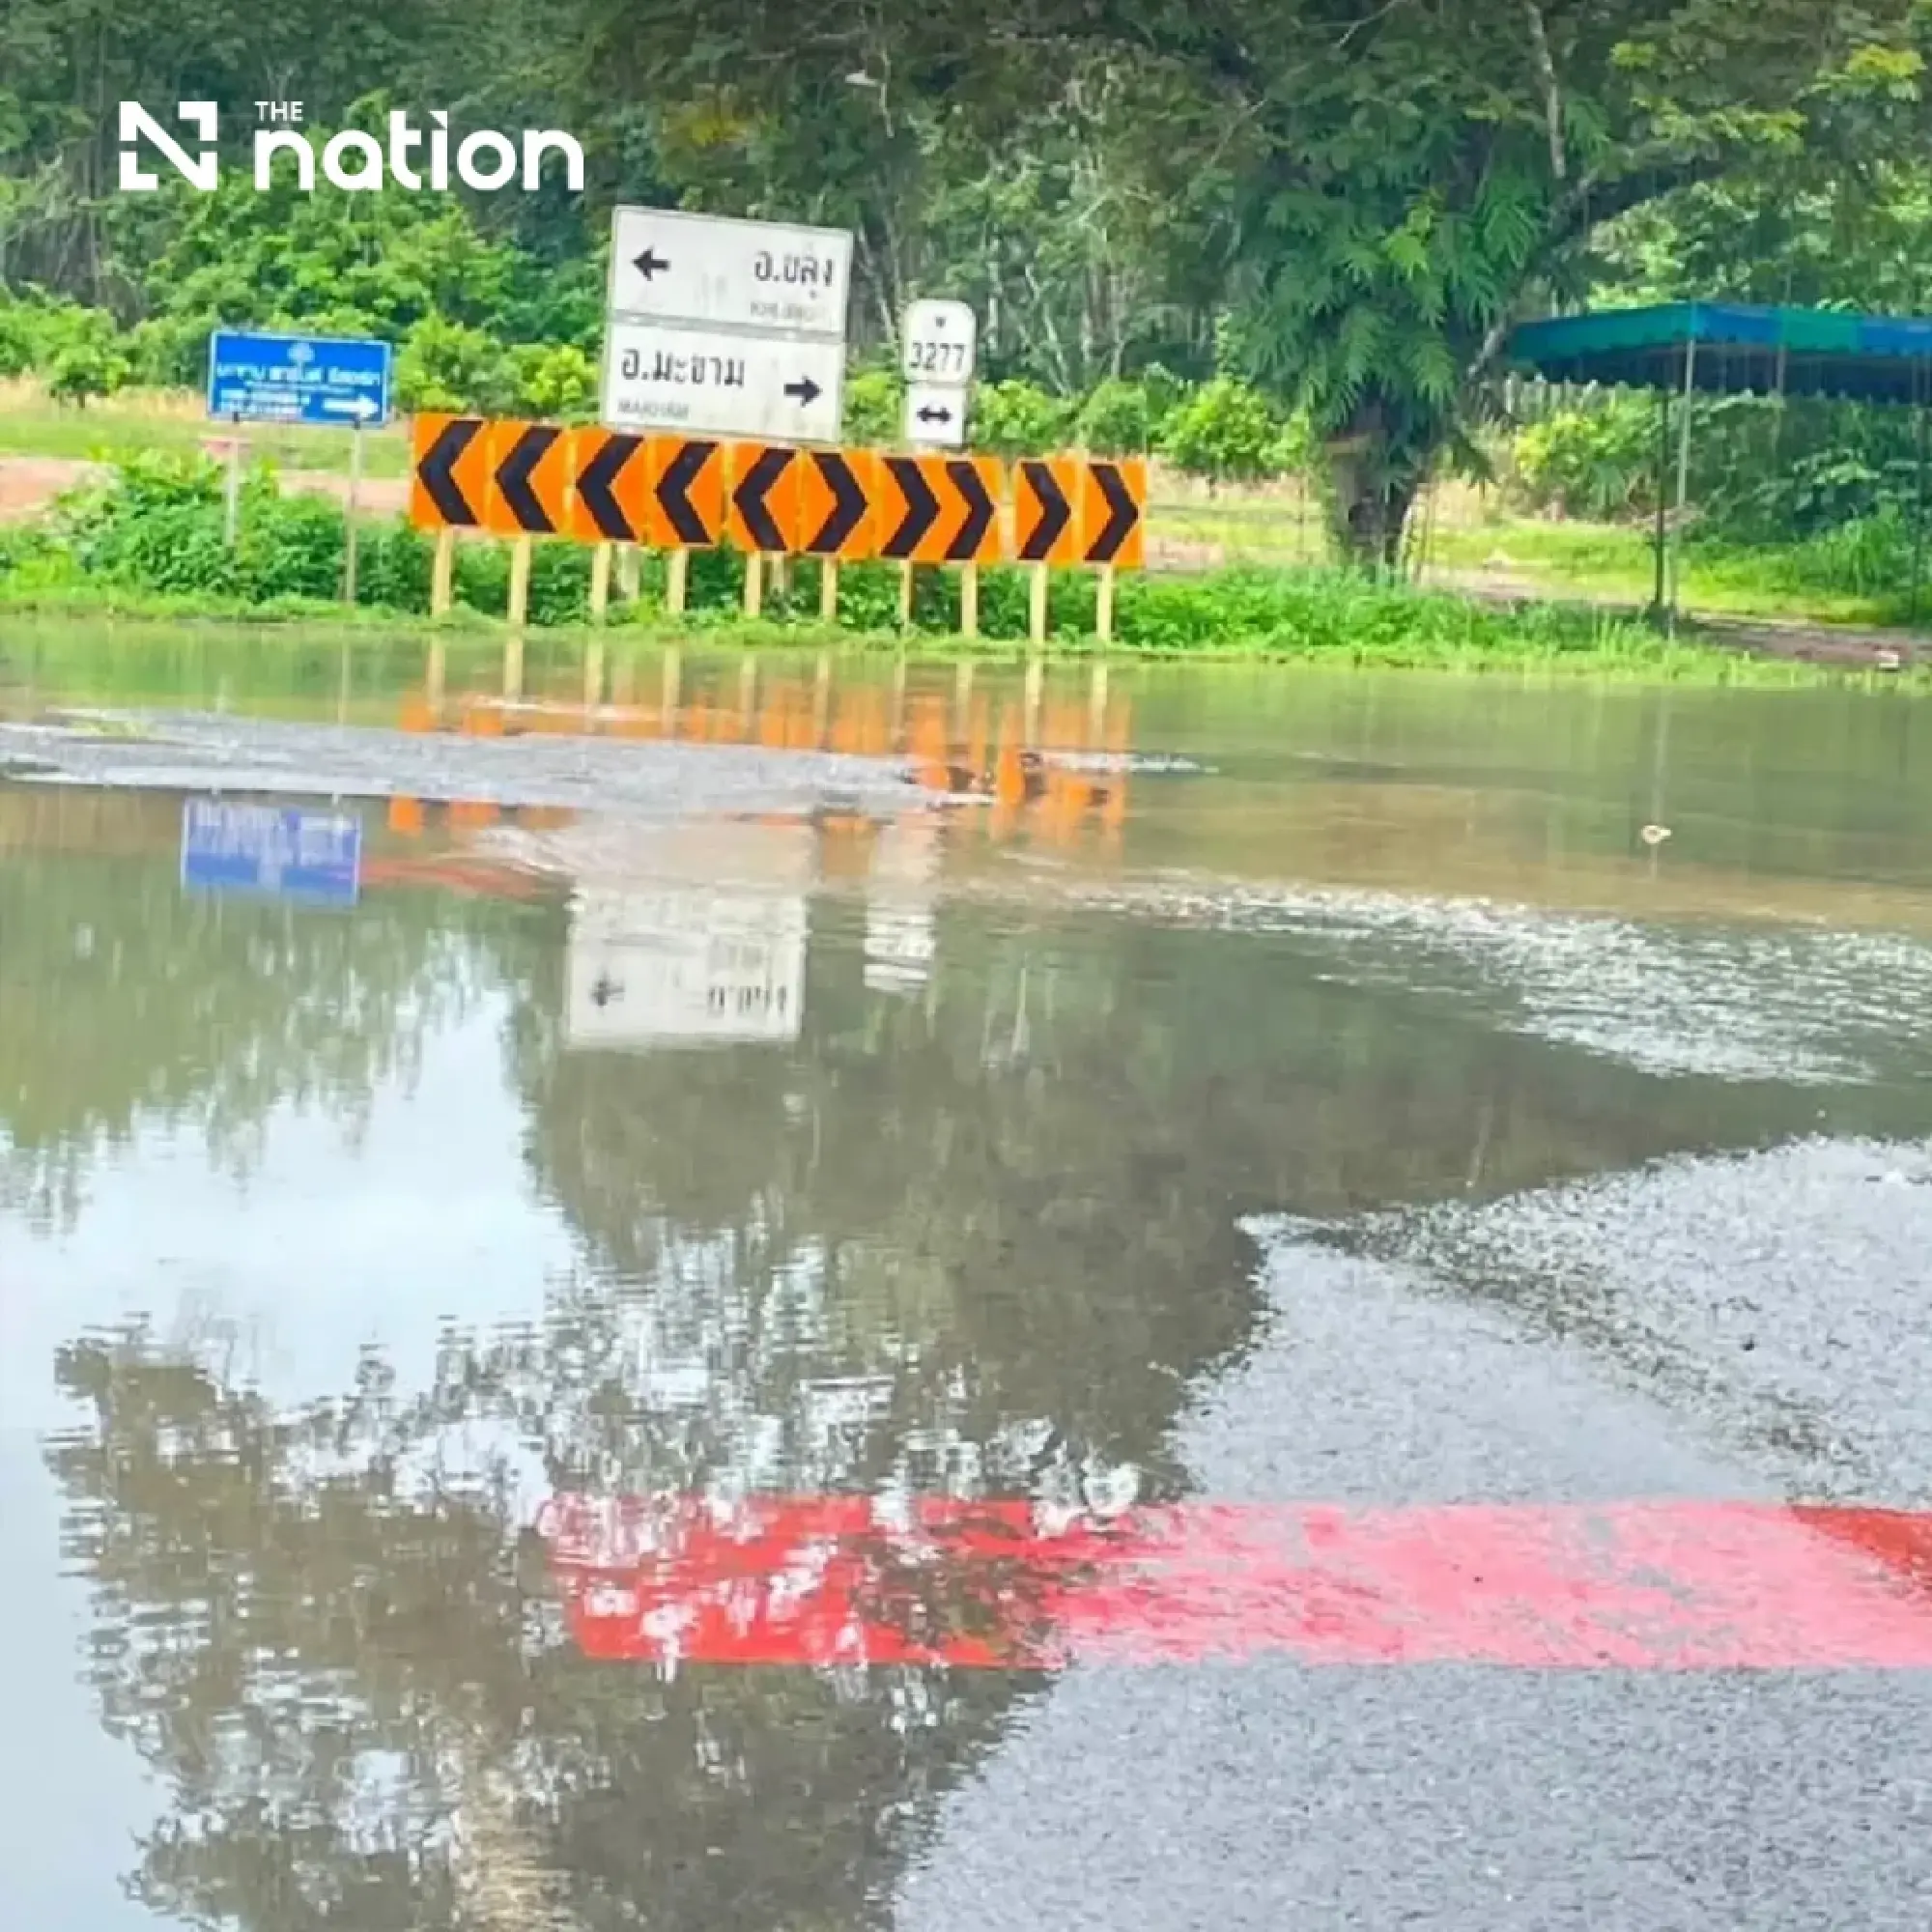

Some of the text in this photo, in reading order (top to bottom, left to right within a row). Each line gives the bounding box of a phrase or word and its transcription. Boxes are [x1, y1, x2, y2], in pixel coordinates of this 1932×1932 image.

[753, 250, 834, 299] อ.ขลุง
[621, 349, 745, 386] อ.มะขาม
[909, 342, 966, 372] 3277
